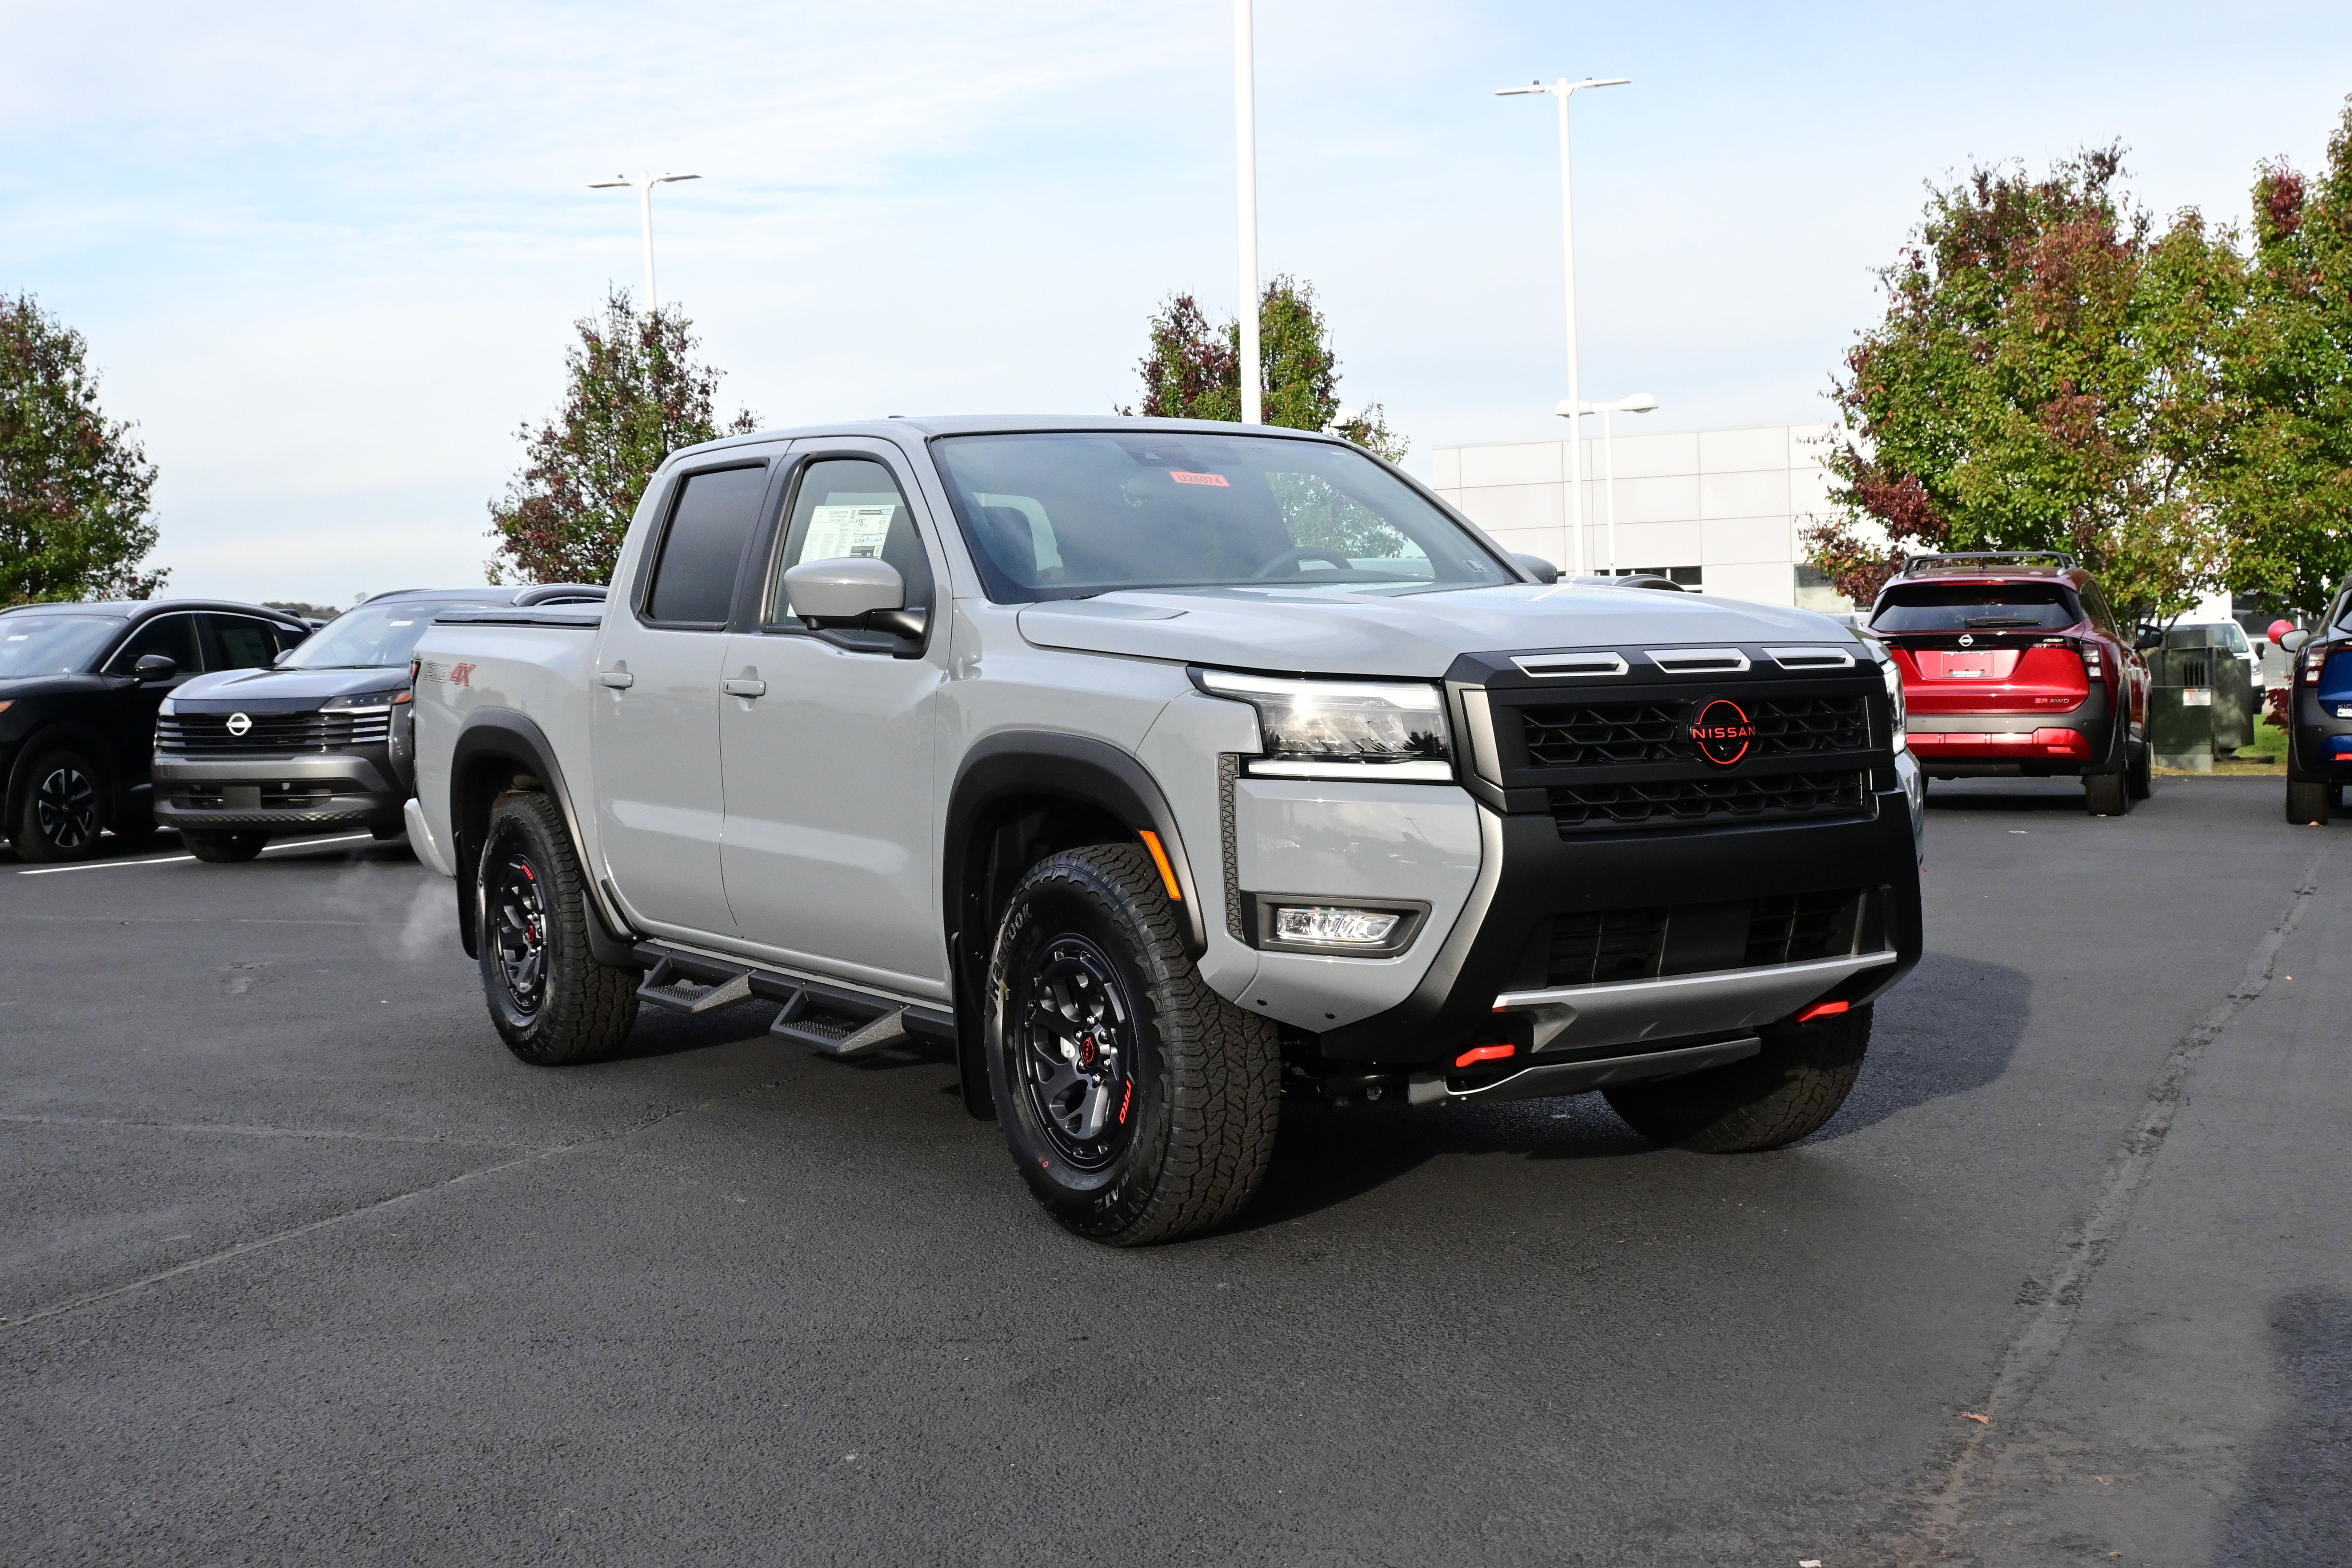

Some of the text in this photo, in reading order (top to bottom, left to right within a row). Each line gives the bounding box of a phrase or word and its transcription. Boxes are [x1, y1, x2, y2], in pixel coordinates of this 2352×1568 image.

[1176, 474, 1222, 485] U26074
[858, 518, 863, 526] 18
[1693, 726, 1755, 739] NISSAN
[521, 864, 534, 880] PRO
[1119, 1080, 1132, 1124] PRO
[1094, 1184, 1119, 1212] AT2
